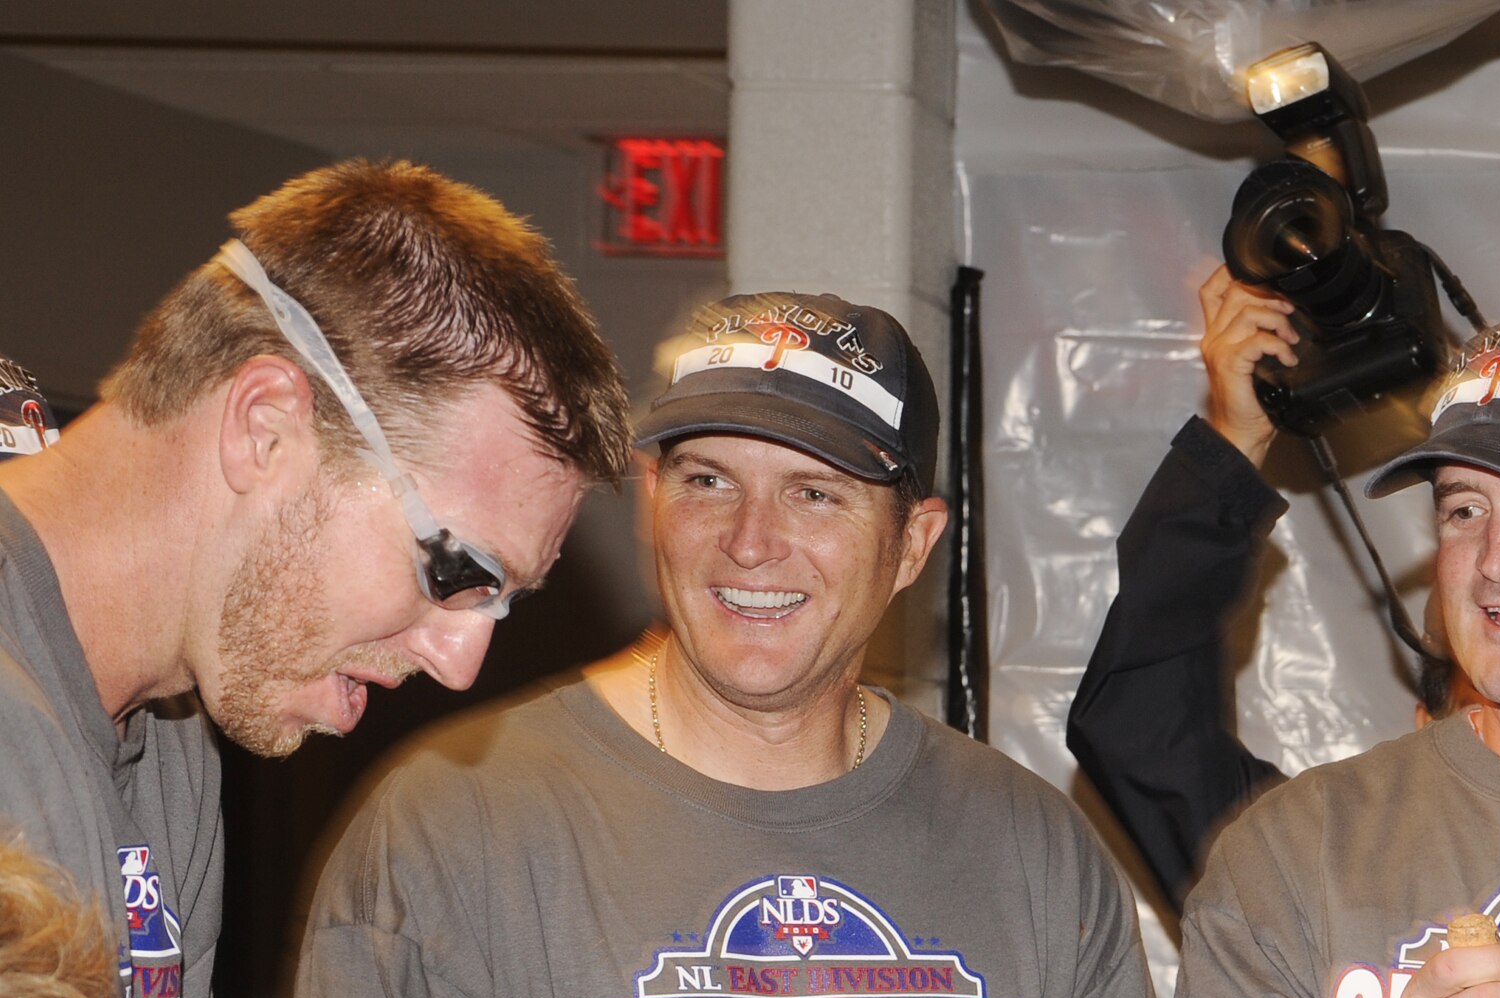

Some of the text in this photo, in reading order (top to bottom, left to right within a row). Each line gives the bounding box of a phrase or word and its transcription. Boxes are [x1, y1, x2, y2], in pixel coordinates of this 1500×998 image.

[618, 138, 725, 243] EXI
[705, 303, 884, 374] PLAYOFFS
[707, 346, 854, 391] 20 10
[124, 875, 159, 910] DS
[760, 897, 841, 926] NLDS
[675, 965, 954, 994] NL EAST DIVISION
